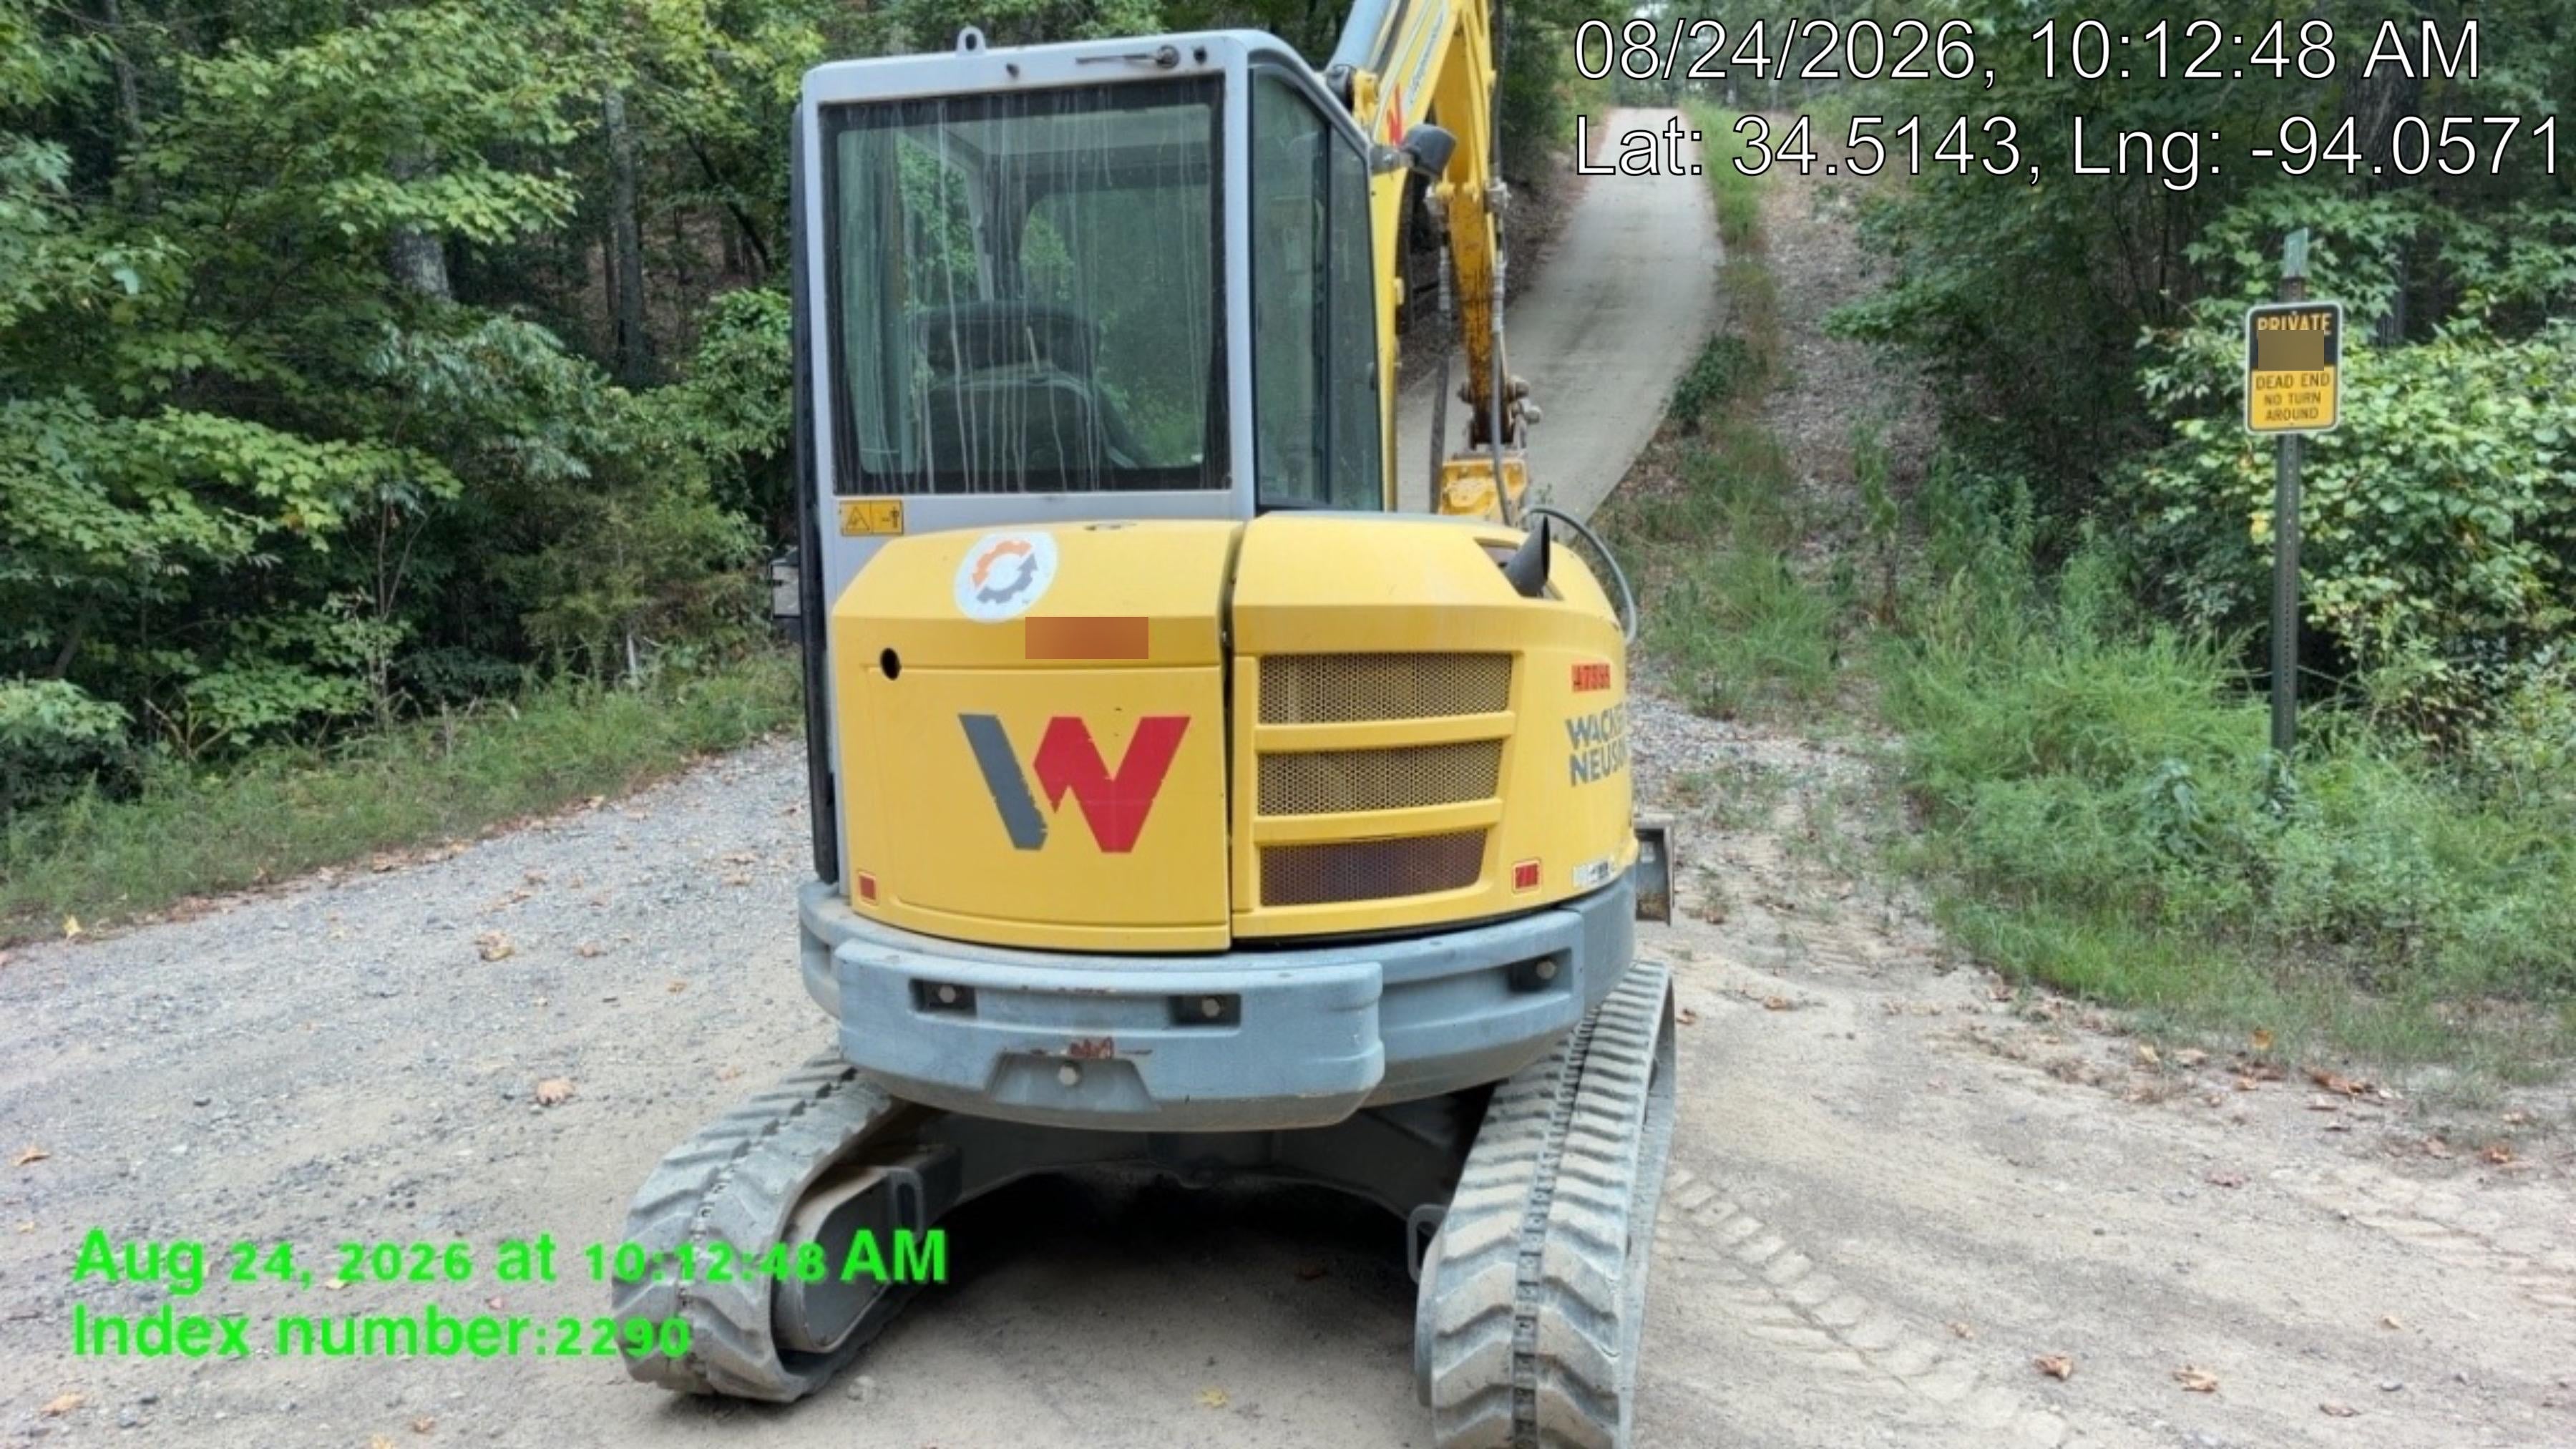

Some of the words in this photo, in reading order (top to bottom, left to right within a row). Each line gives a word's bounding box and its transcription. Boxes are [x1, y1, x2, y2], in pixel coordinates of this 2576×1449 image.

[2257, 313, 2333, 337] PRIVATE
[2255, 374, 2294, 390] DEAD
[2301, 372, 2331, 387] END
[2264, 394, 2283, 406] NO
[2289, 391, 2321, 404] TURN
[2265, 406, 2319, 421] AROUND
[957, 713, 1191, 854] W
